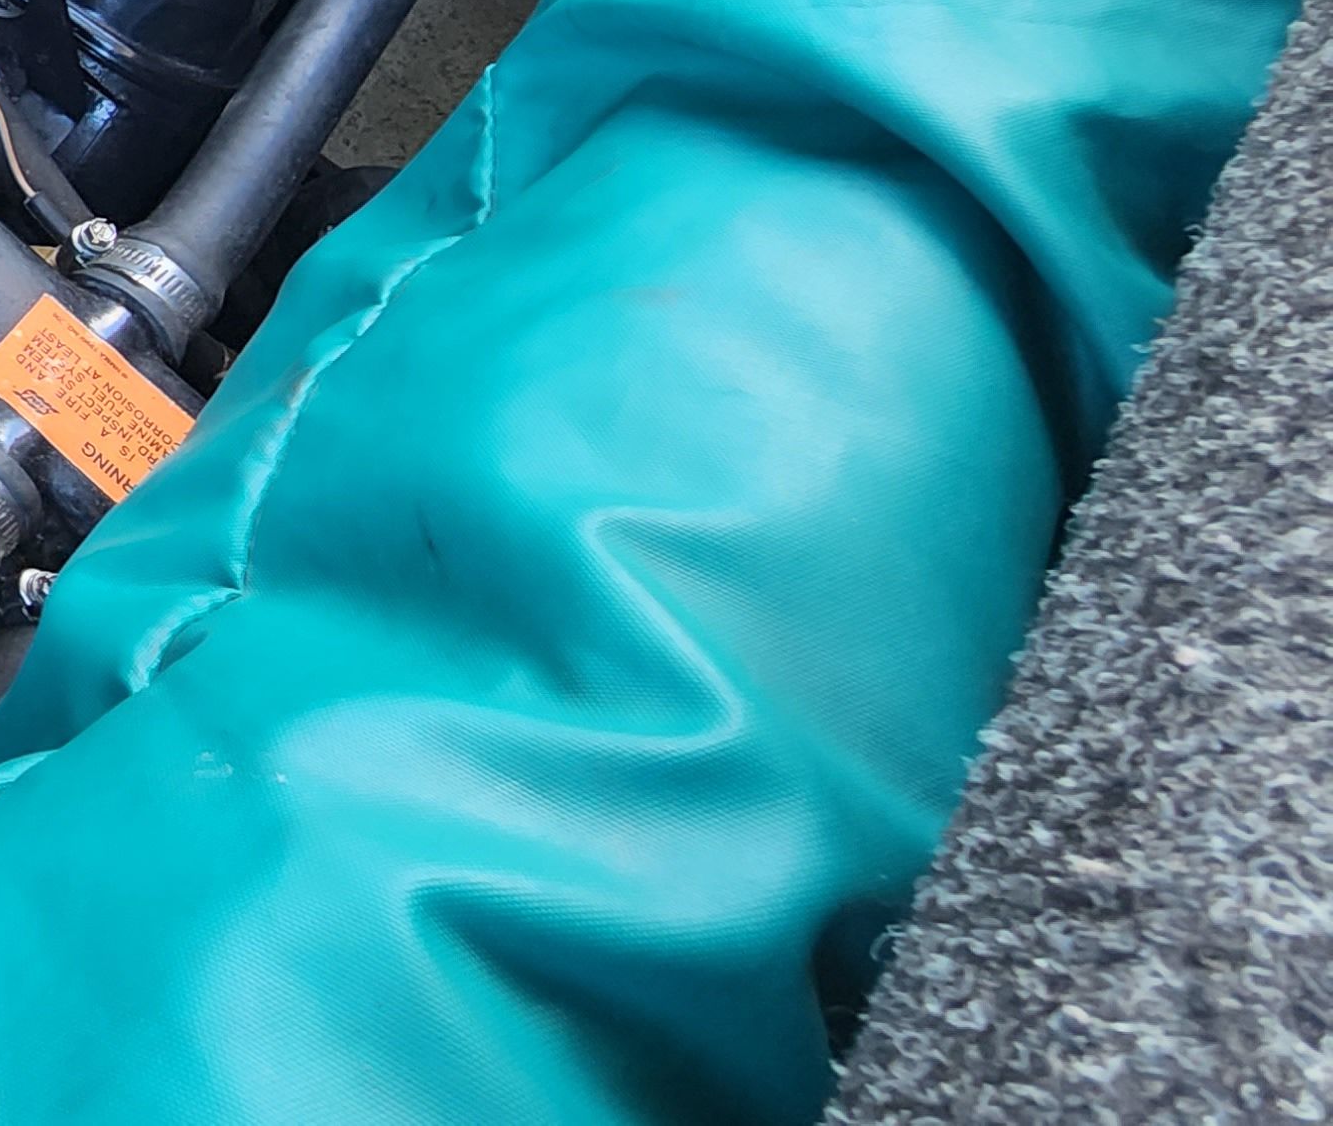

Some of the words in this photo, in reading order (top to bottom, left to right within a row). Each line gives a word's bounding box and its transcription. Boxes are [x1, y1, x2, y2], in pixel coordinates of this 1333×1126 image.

[37, 325, 82, 365] LEAST
[12, 351, 49, 383] AND
[22, 344, 77, 392] SYSTEM
[82, 364, 103, 383] AT
[52, 387, 93, 422] FIRE
[77, 390, 133, 444] INSPECT
[88, 384, 125, 418] FUEL
[117, 443, 138, 463] IS
